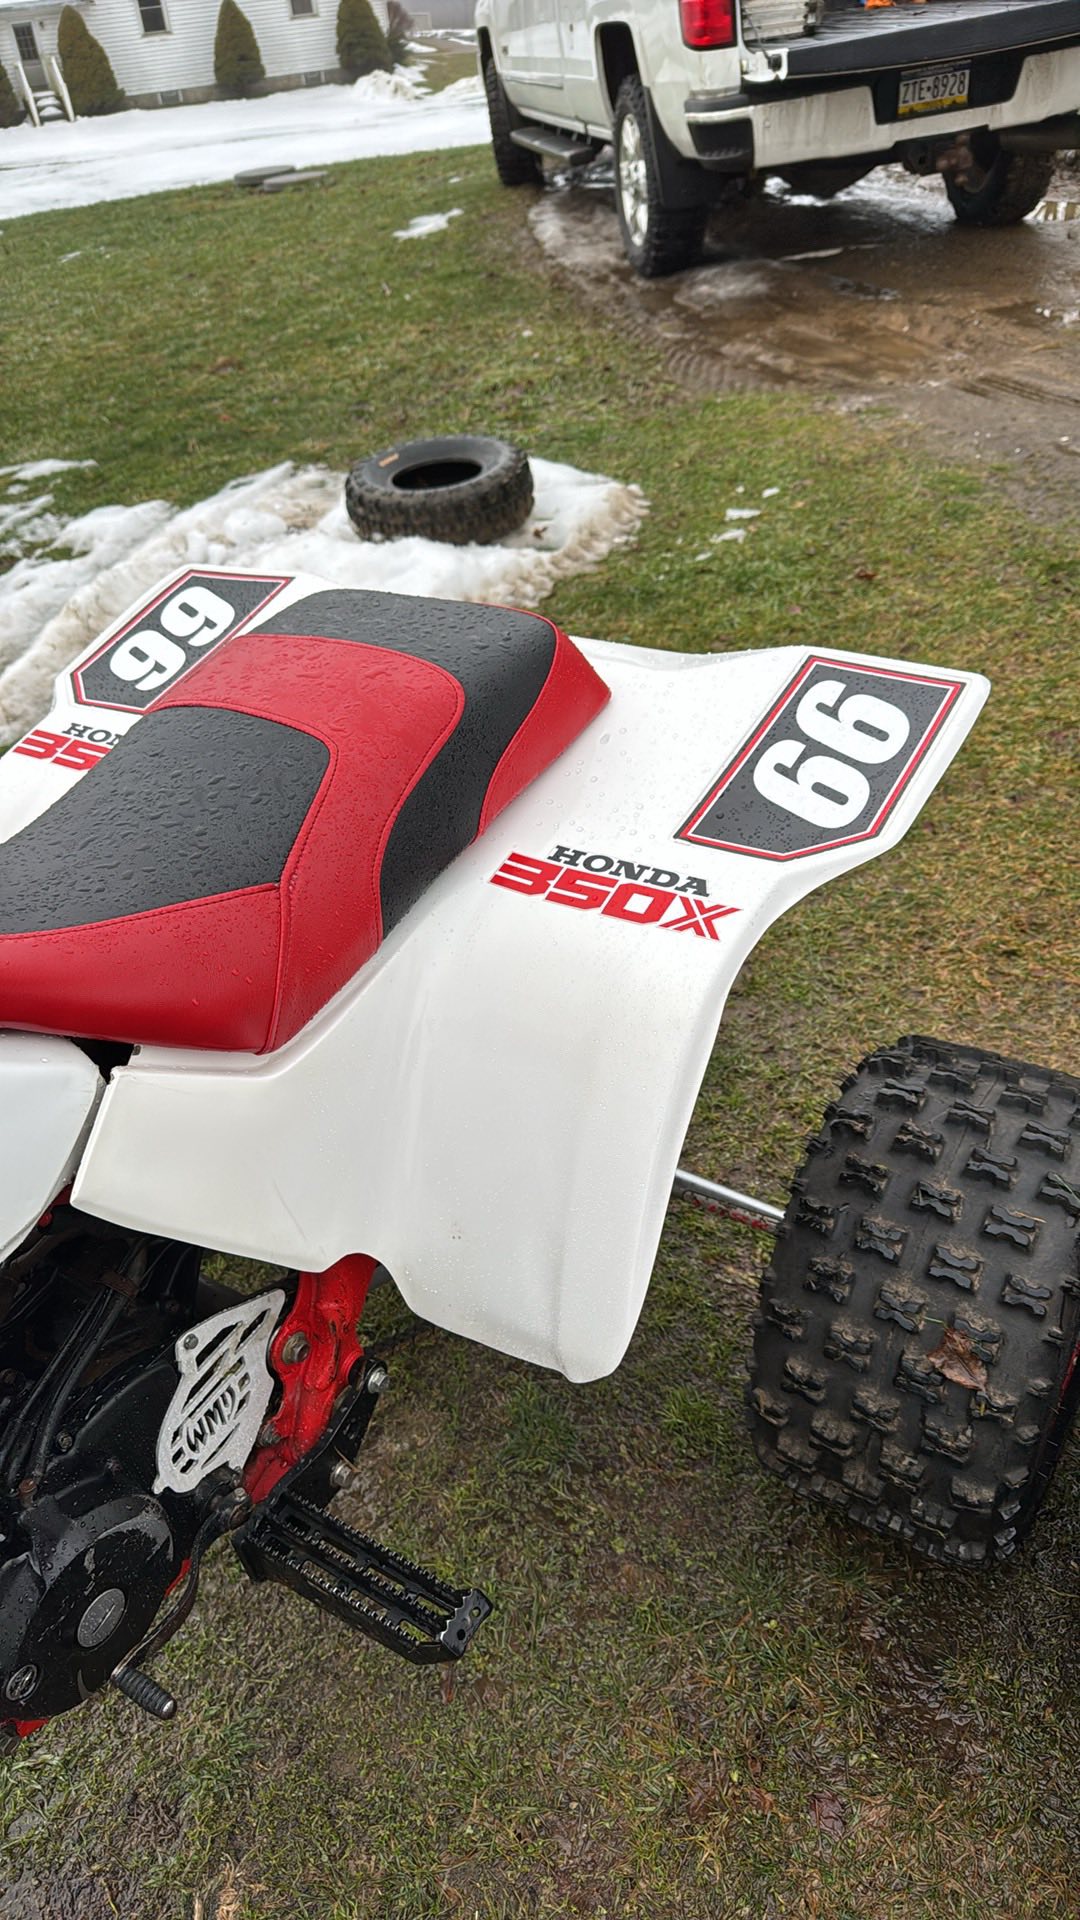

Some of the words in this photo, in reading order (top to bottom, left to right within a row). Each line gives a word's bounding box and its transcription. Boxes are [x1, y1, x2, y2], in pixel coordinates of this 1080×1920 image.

[753, 680, 911, 829] 66
[489, 851, 742, 941] 350X
[547, 845, 710, 898] HONDA
